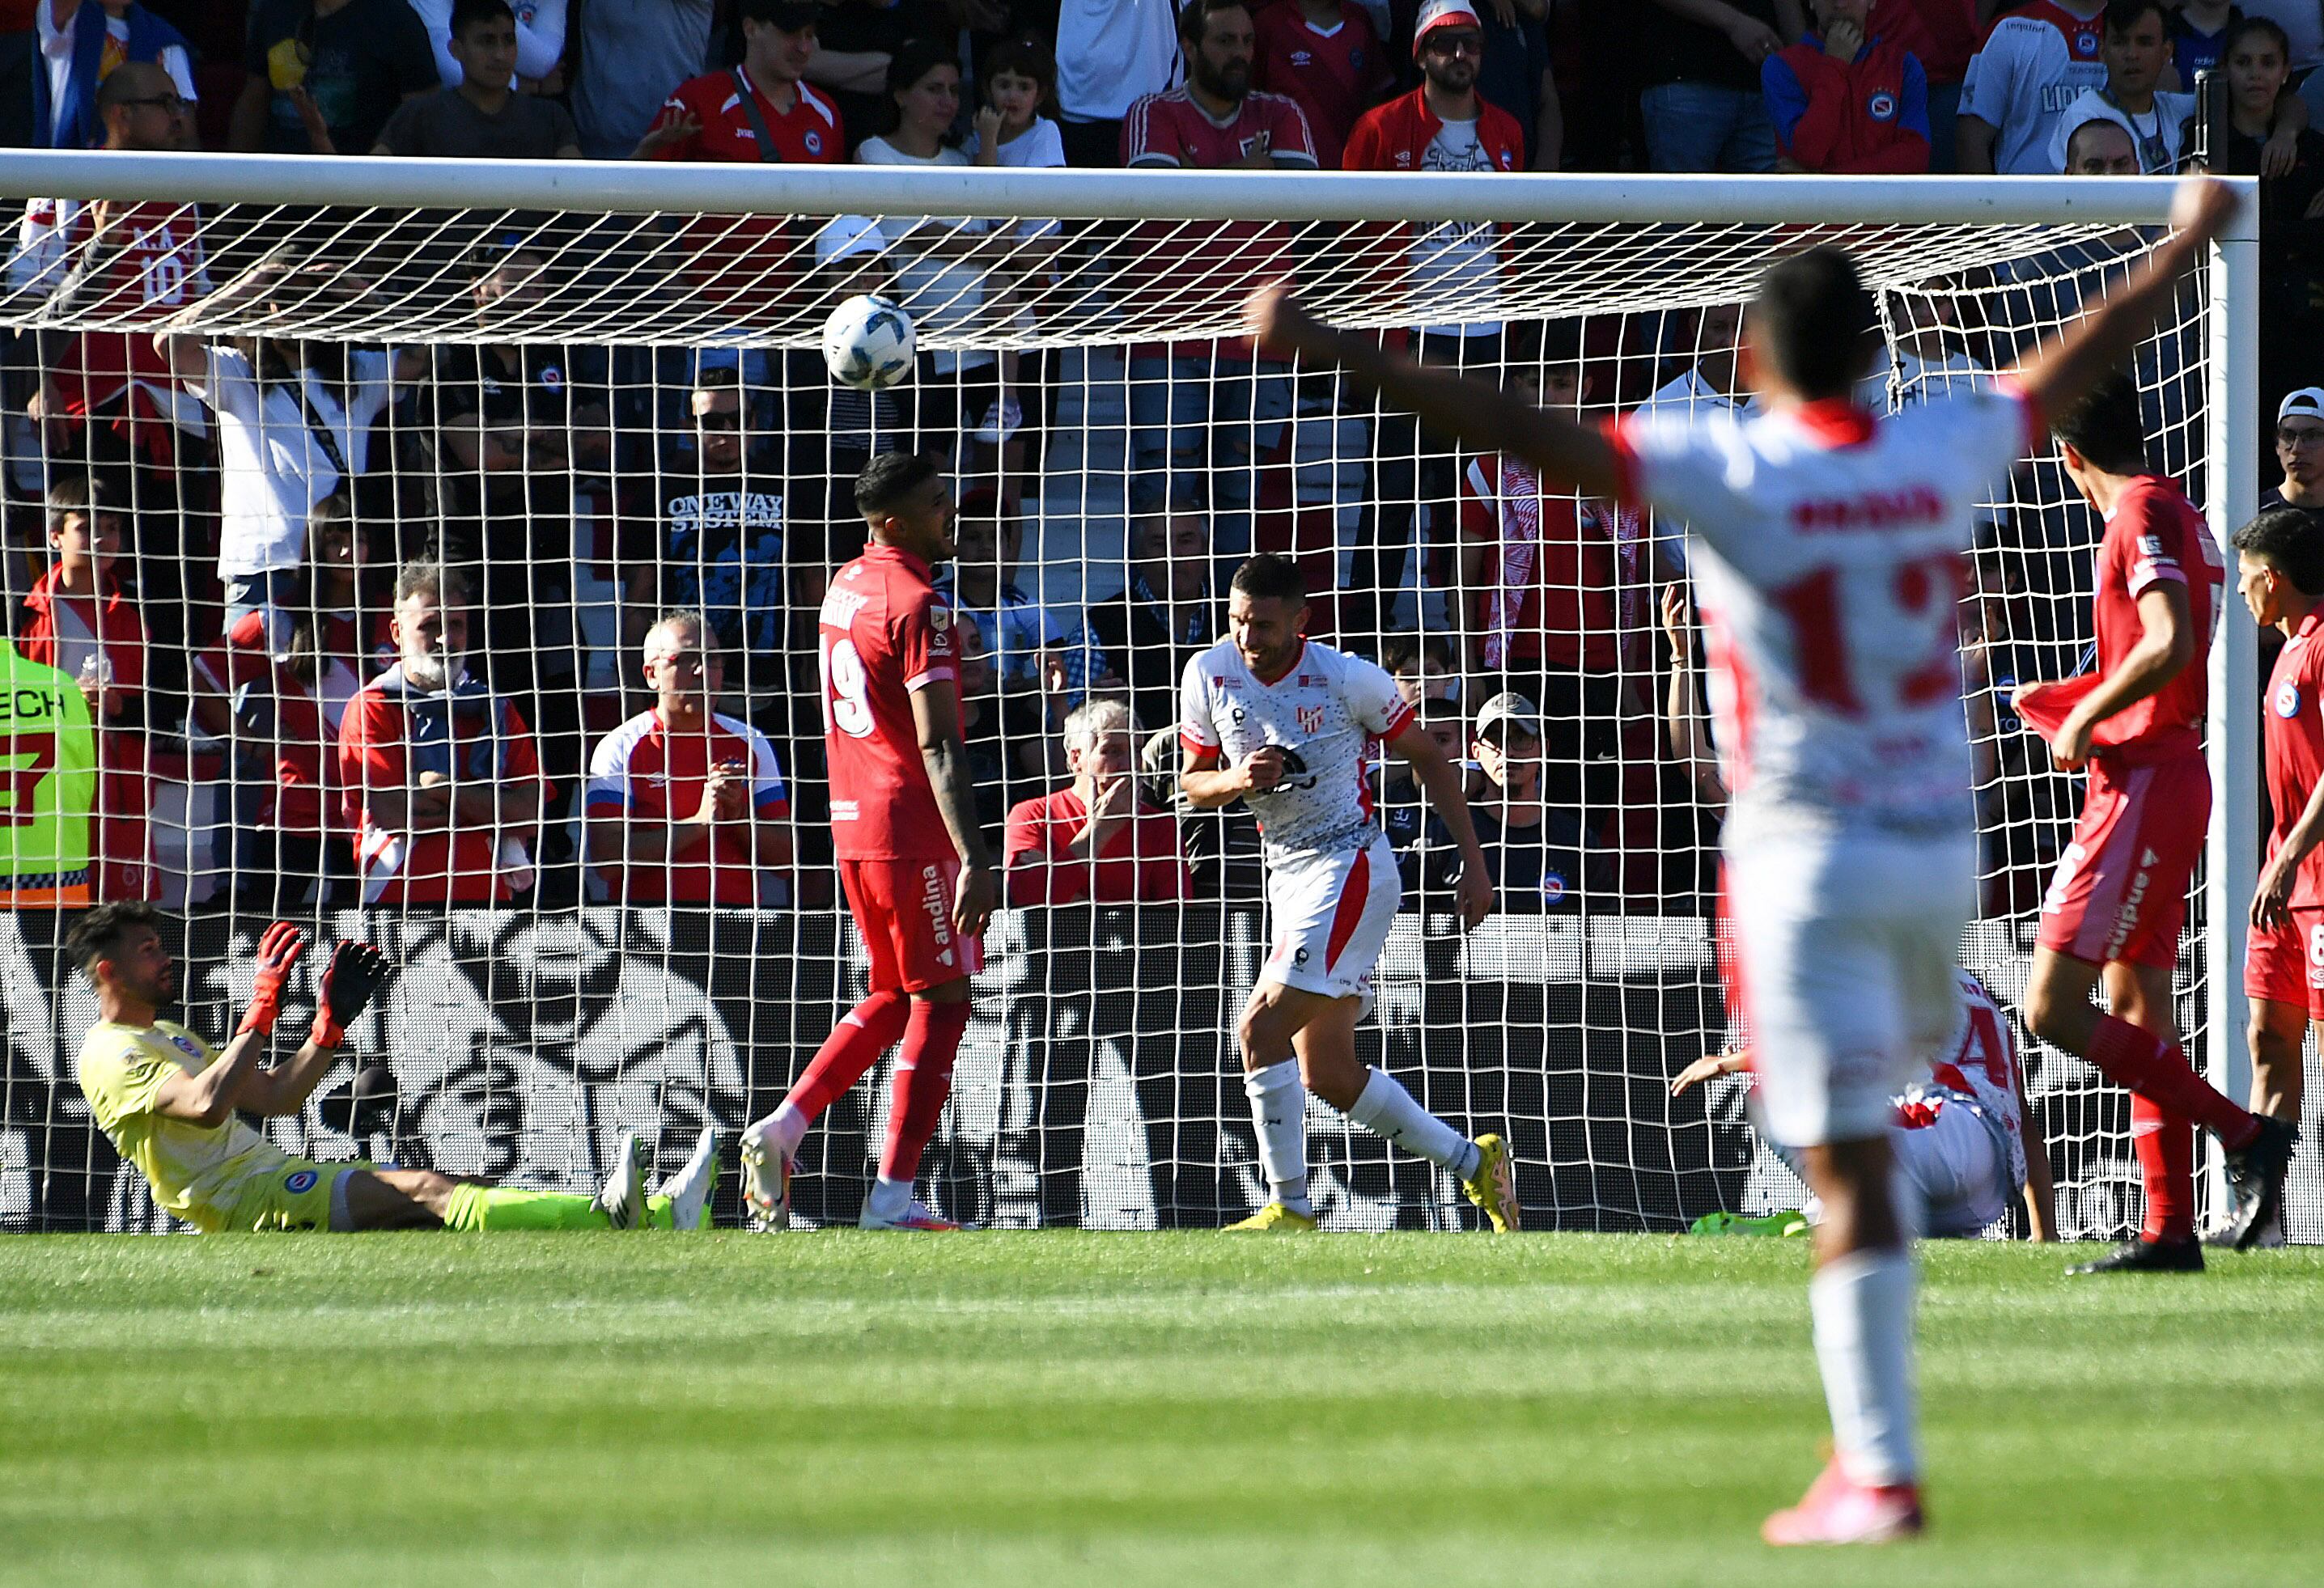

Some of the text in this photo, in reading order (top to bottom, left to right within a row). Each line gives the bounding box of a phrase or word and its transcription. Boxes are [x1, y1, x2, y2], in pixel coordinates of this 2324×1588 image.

[141, 255, 183, 304] 10
[668, 491, 783, 515] ONE WAY
[922, 865, 950, 946] andina
[2106, 872, 2150, 959] andina
